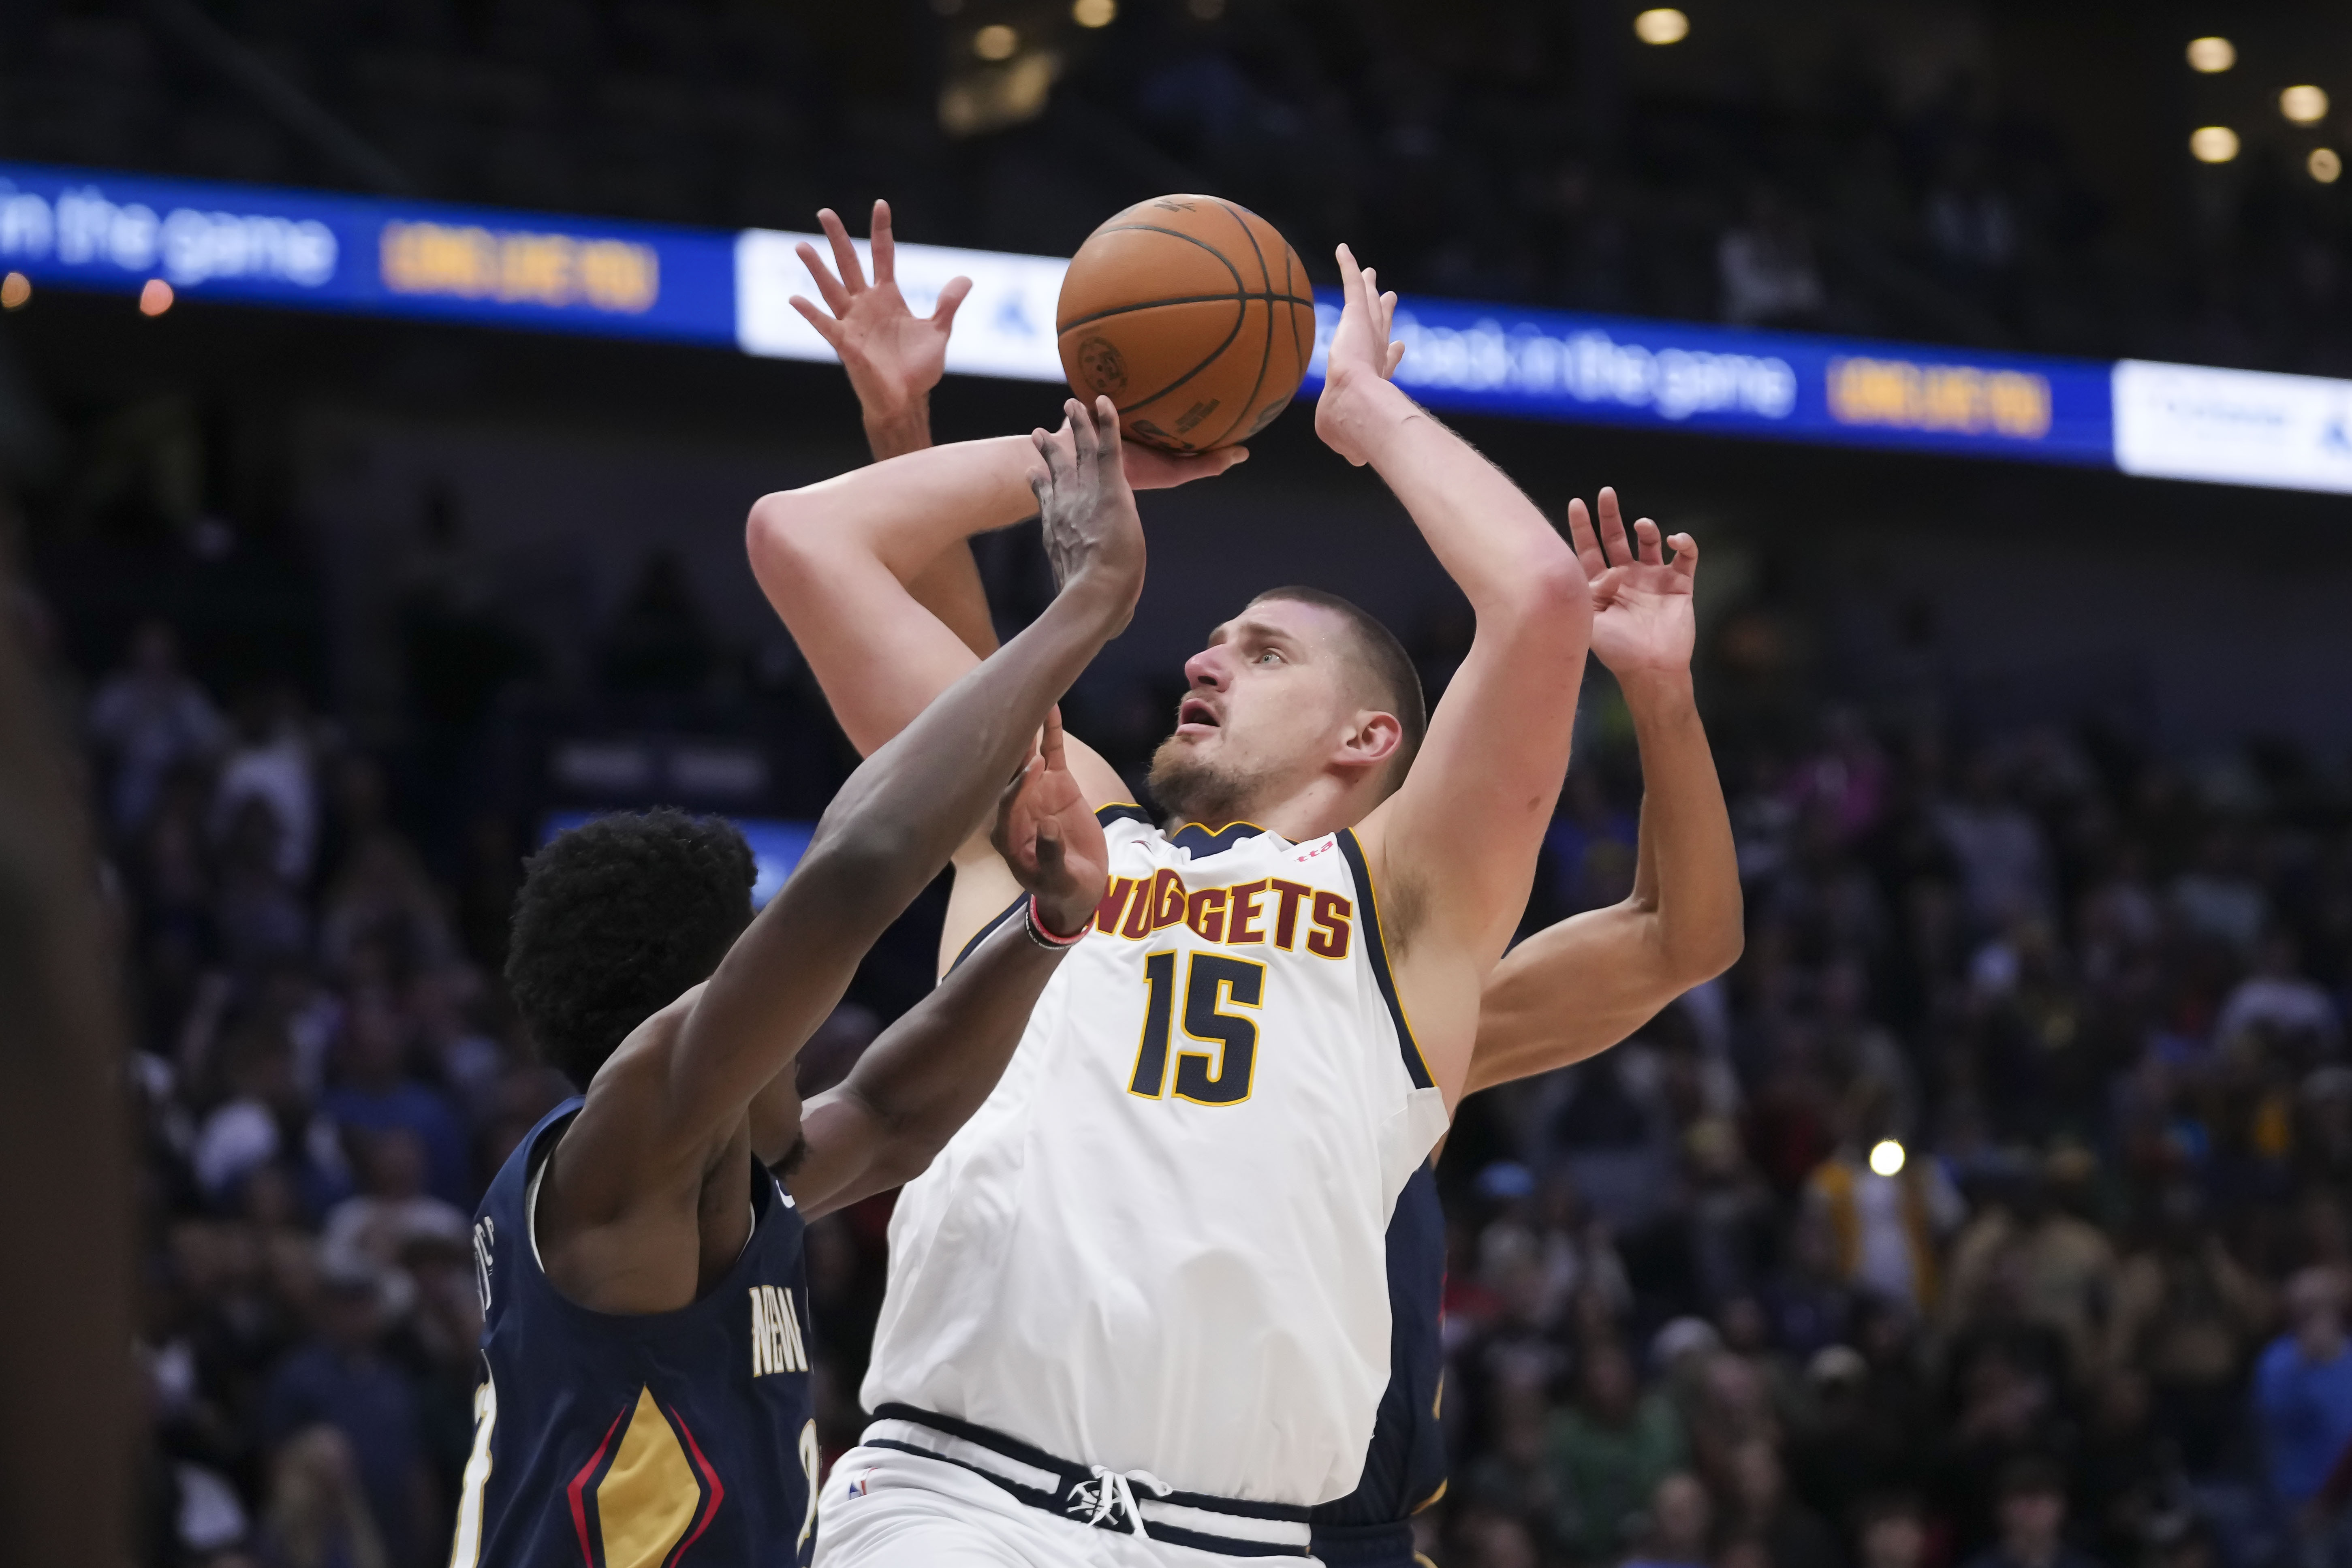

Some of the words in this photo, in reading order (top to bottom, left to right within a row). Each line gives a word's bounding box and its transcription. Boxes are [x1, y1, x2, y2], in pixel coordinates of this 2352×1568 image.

[1093, 867, 1353, 960] NUGGETS
[1128, 949, 1267, 1107] 15
[749, 1285, 809, 1378] NEW
